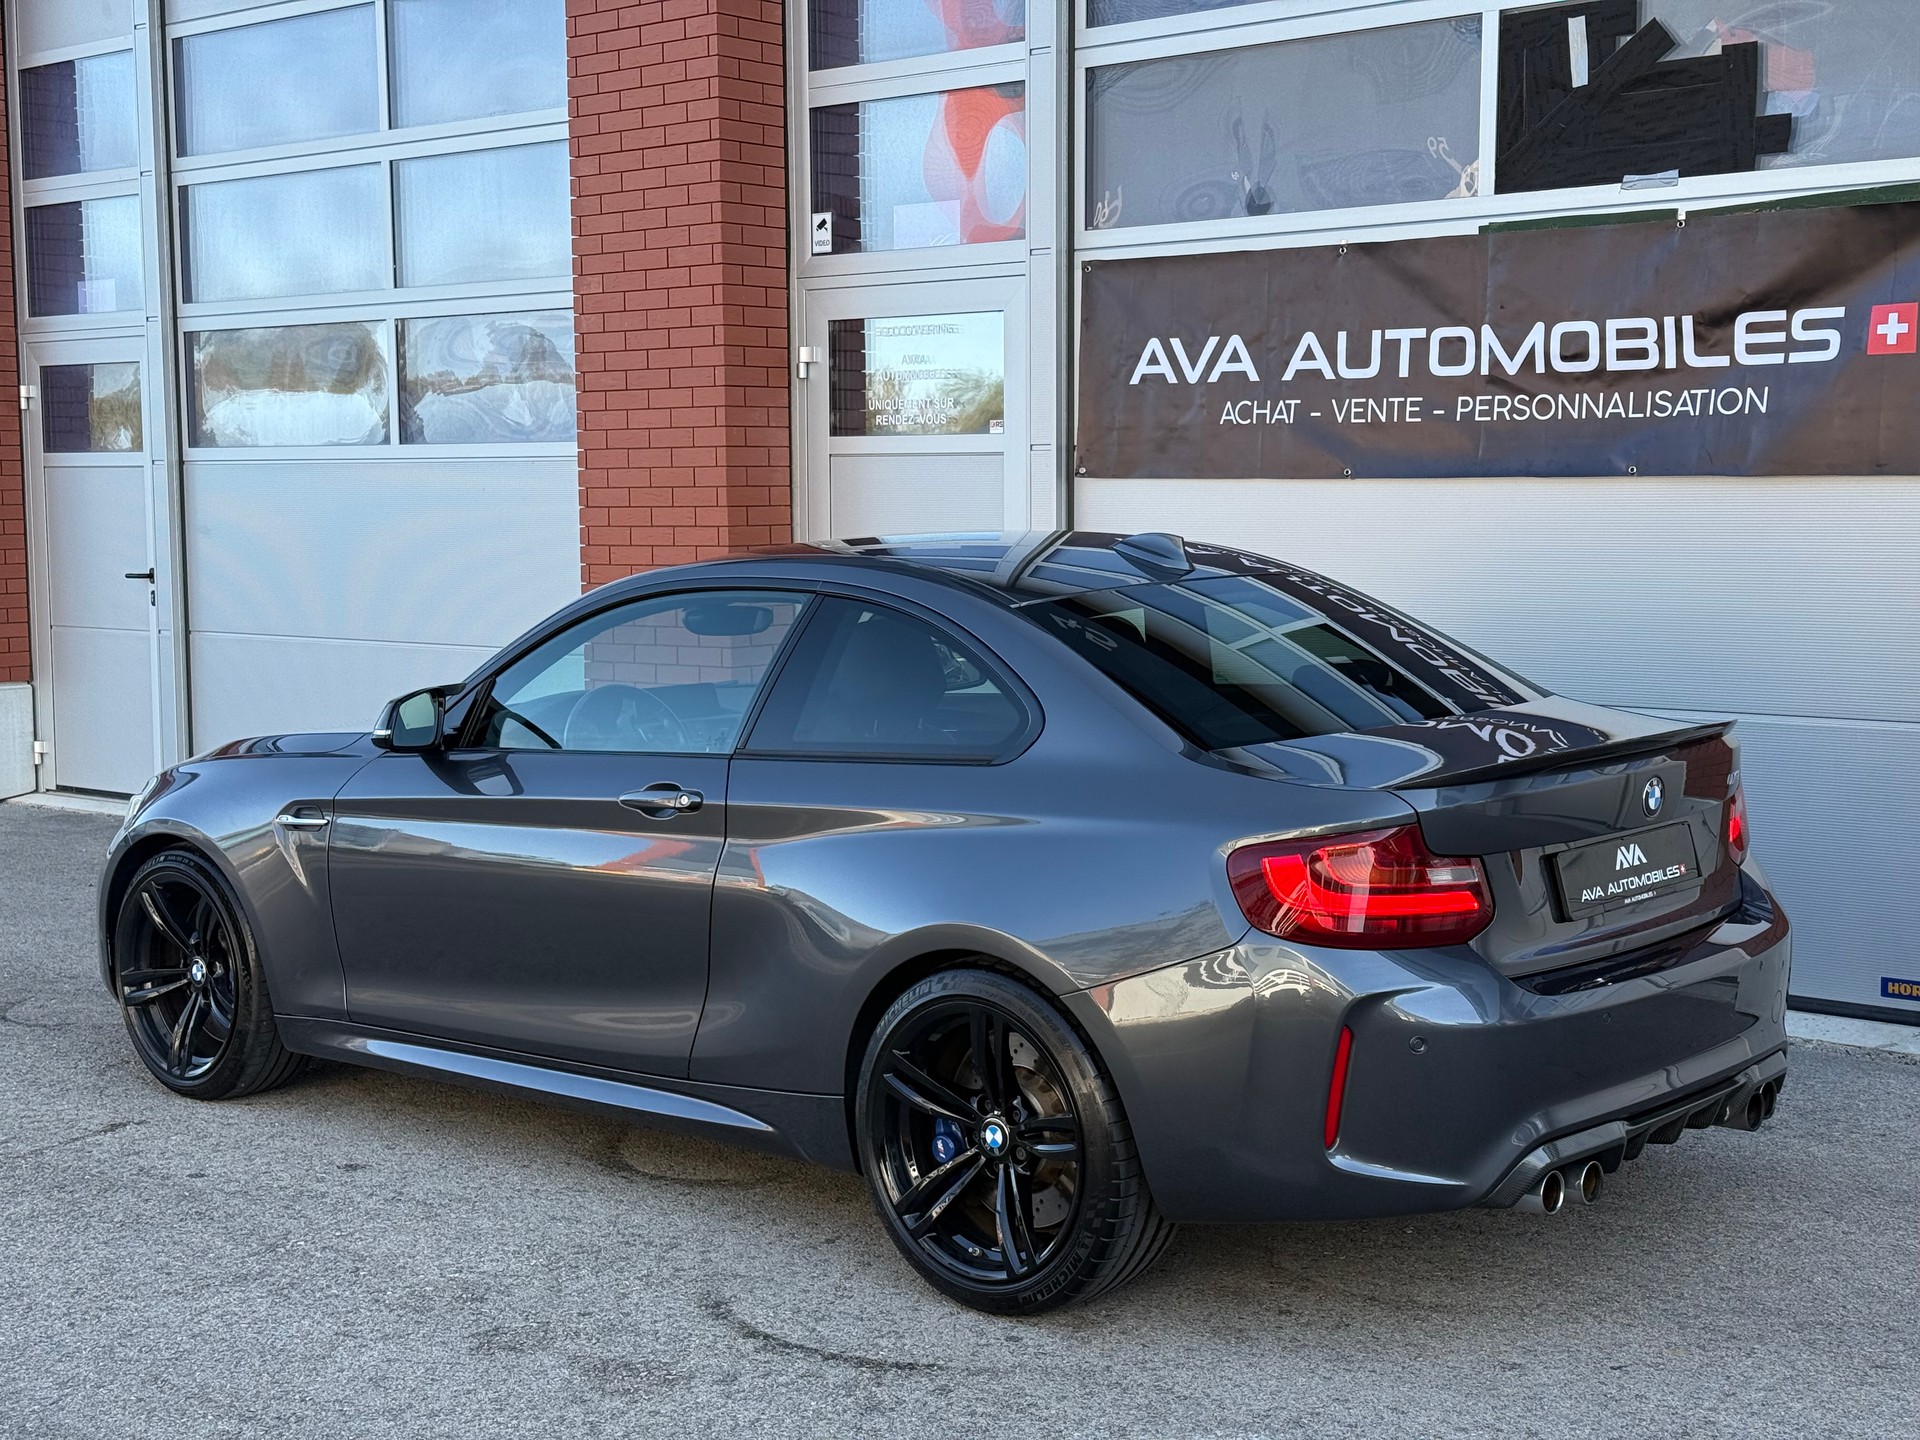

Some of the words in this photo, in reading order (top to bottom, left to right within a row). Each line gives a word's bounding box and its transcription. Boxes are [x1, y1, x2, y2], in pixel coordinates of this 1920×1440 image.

[1128, 334, 1261, 385] AVA
[1281, 307, 1846, 381] AUTOMOBILES
[933, 397, 954, 409] SUR
[1219, 400, 1302, 425] ACHAT
[1331, 397, 1424, 424] VENTE
[1456, 386, 1769, 422] PERSONNALISATION
[1615, 843, 1648, 871] AVA
[1581, 885, 1606, 903] AVA
[1607, 864, 1681, 896] AUTOMOBILES
